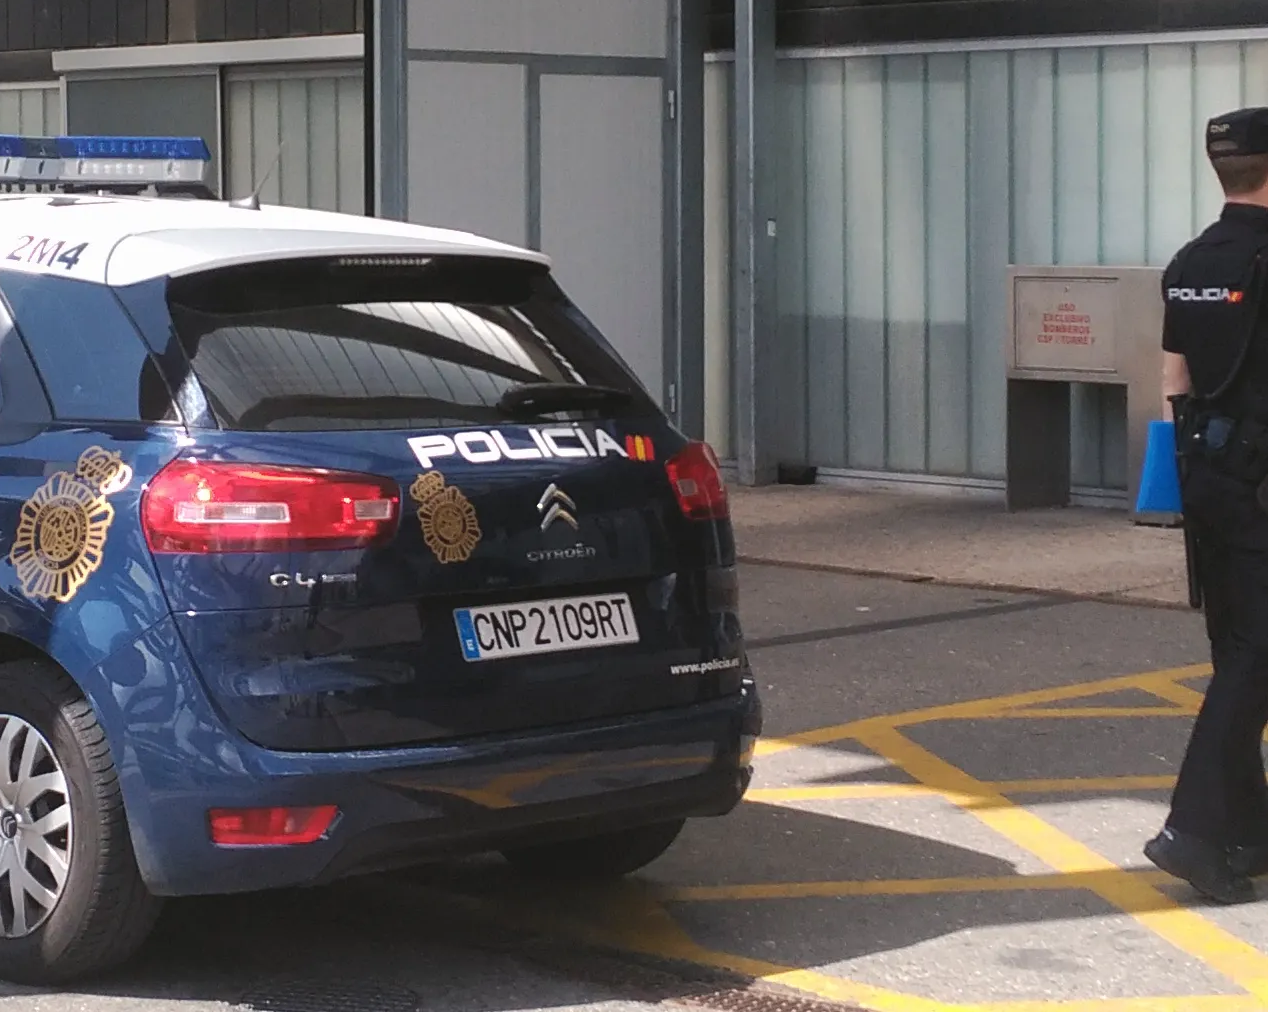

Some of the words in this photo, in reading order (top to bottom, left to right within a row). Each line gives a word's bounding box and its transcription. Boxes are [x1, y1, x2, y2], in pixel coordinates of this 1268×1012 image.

[1168, 288, 1230, 301] POLICIA
[407, 421, 629, 469] POLICÍA
[269, 572, 317, 589] C4
